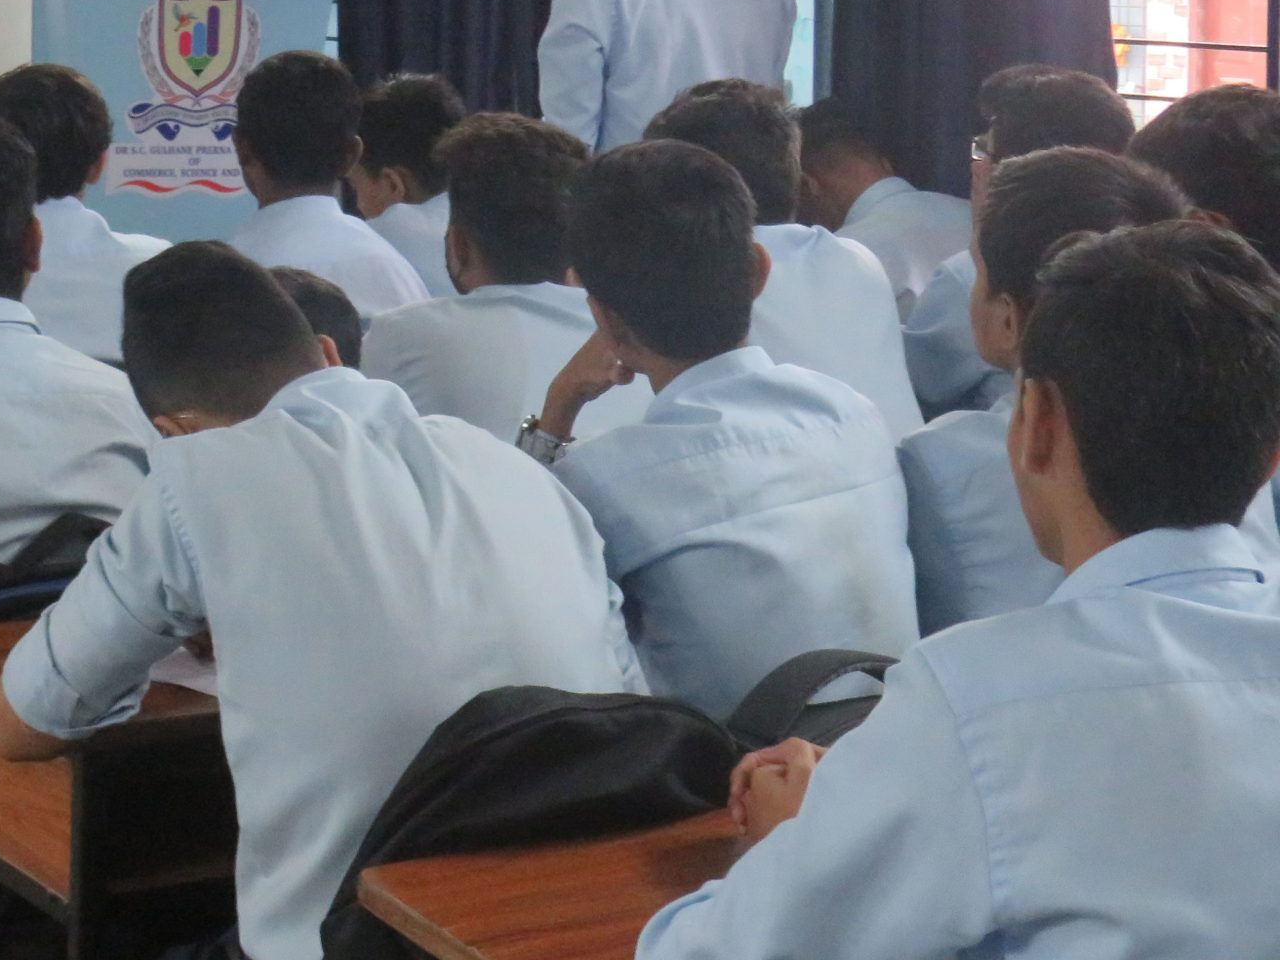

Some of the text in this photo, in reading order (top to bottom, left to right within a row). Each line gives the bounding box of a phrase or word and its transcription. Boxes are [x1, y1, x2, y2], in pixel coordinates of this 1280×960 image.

[150, 145, 193, 155] GULHANE
[195, 145, 233, 154] PRERNA
[187, 157, 202, 167] OF
[180, 168, 218, 178] SCIENCE
